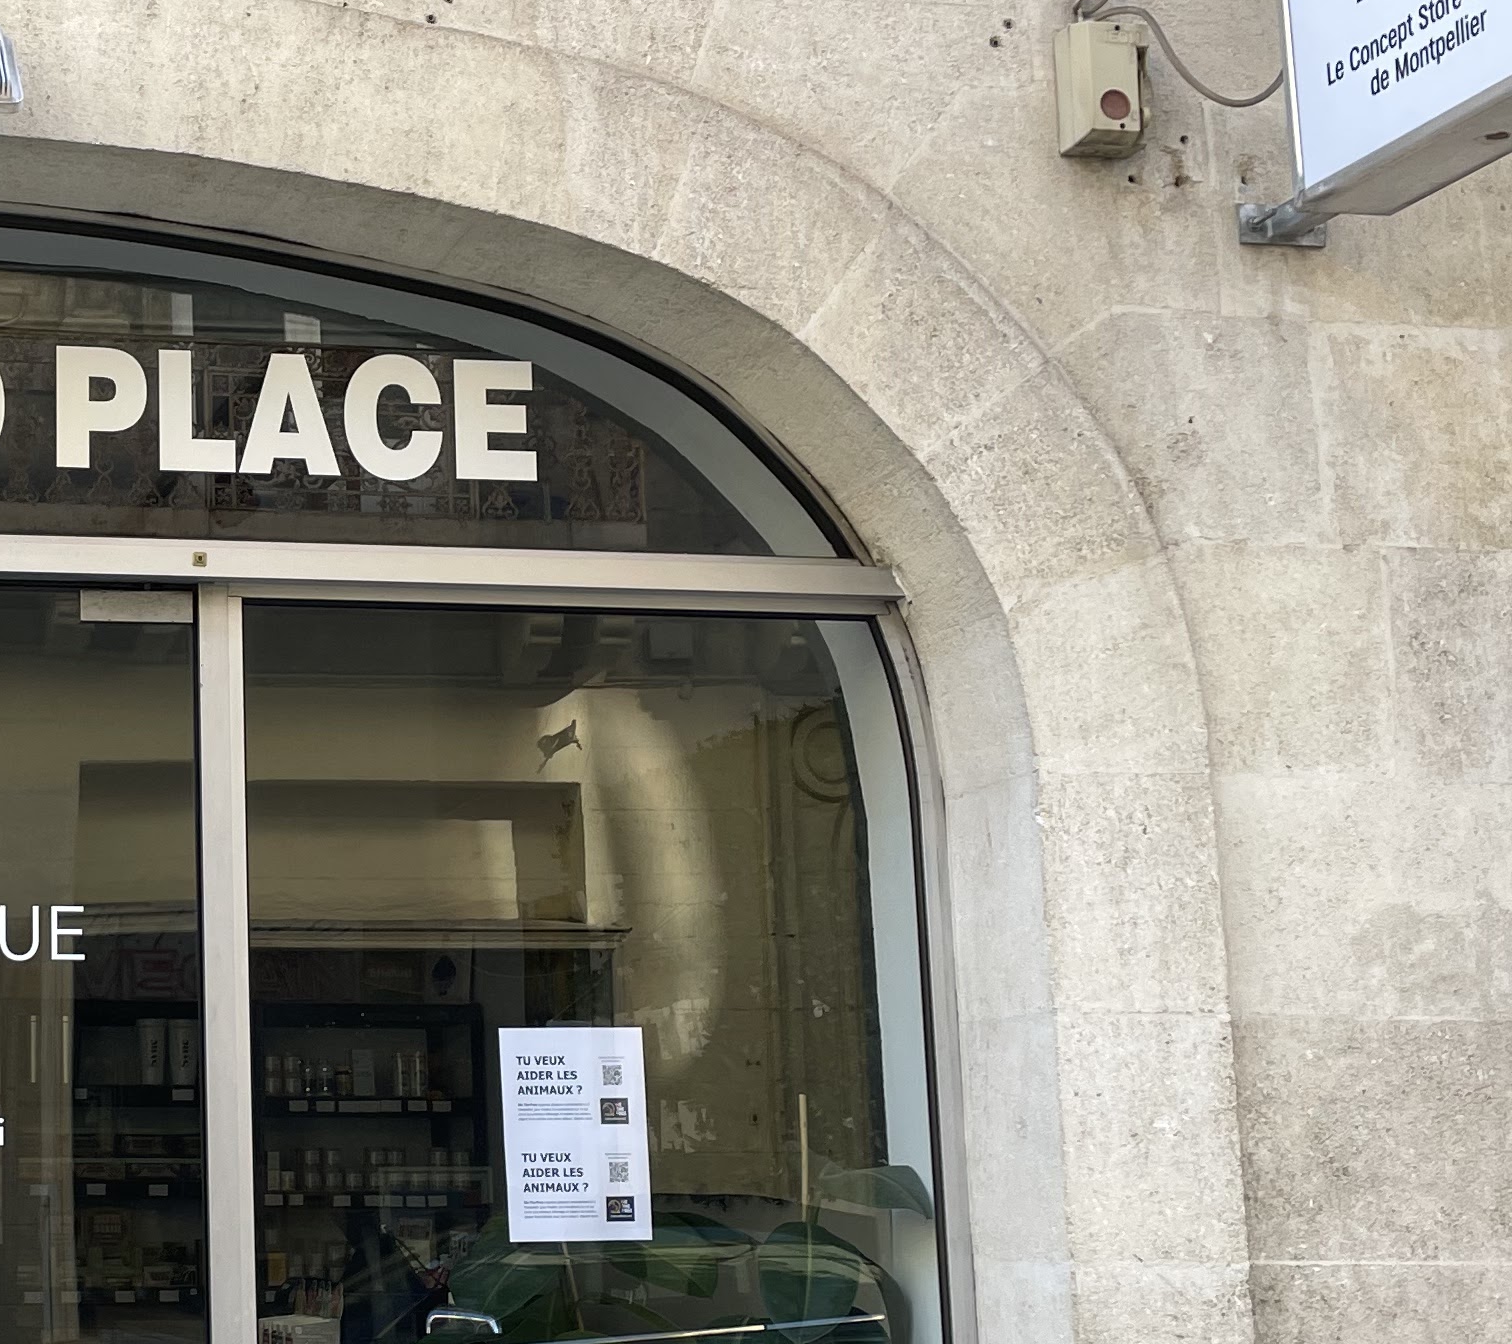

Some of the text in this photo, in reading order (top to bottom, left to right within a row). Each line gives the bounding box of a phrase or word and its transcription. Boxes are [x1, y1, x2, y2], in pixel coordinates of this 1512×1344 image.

[1325, 58, 1345, 87] Le
[1349, 13, 1415, 72] Concept
[1370, 9, 1488, 96] de Montpellier
[54, 345, 540, 483] PLACE
[516, 1055, 566, 1066] TU VEUX
[517, 1070, 578, 1081] AIDER LES
[518, 1085, 574, 1095] ANIMAUX
[521, 1152, 572, 1163] TU VEUX
[522, 1167, 584, 1178] AIDER LES
[523, 1182, 579, 1193] ANIMAUX
